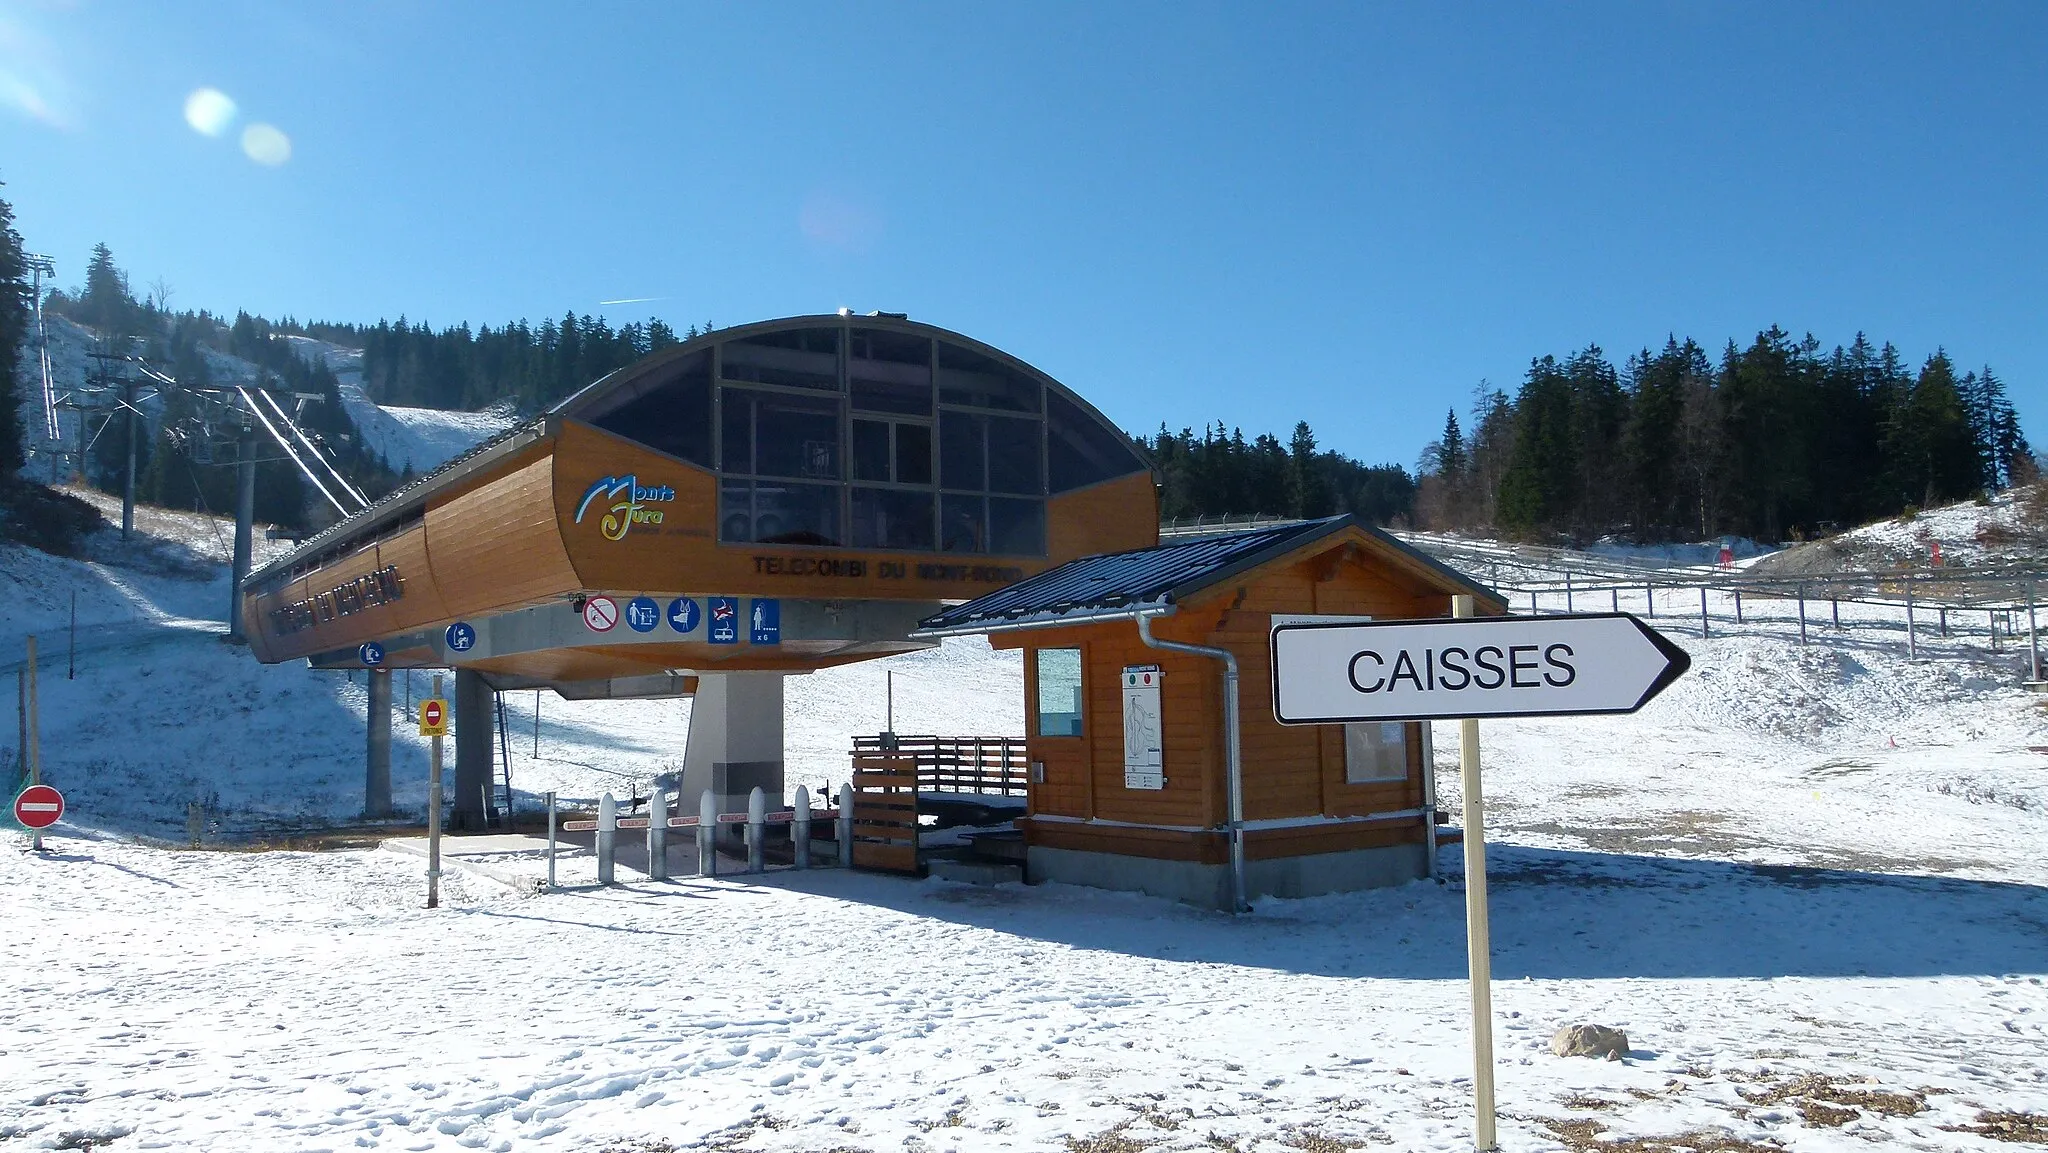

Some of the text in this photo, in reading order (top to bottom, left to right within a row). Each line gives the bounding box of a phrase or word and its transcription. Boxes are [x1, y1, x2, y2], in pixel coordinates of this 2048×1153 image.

[574, 474, 676, 524] Monts
[600, 501, 665, 541] Jura
[877, 562, 906, 580] DU
[1347, 643, 1576, 693] CAISSES
